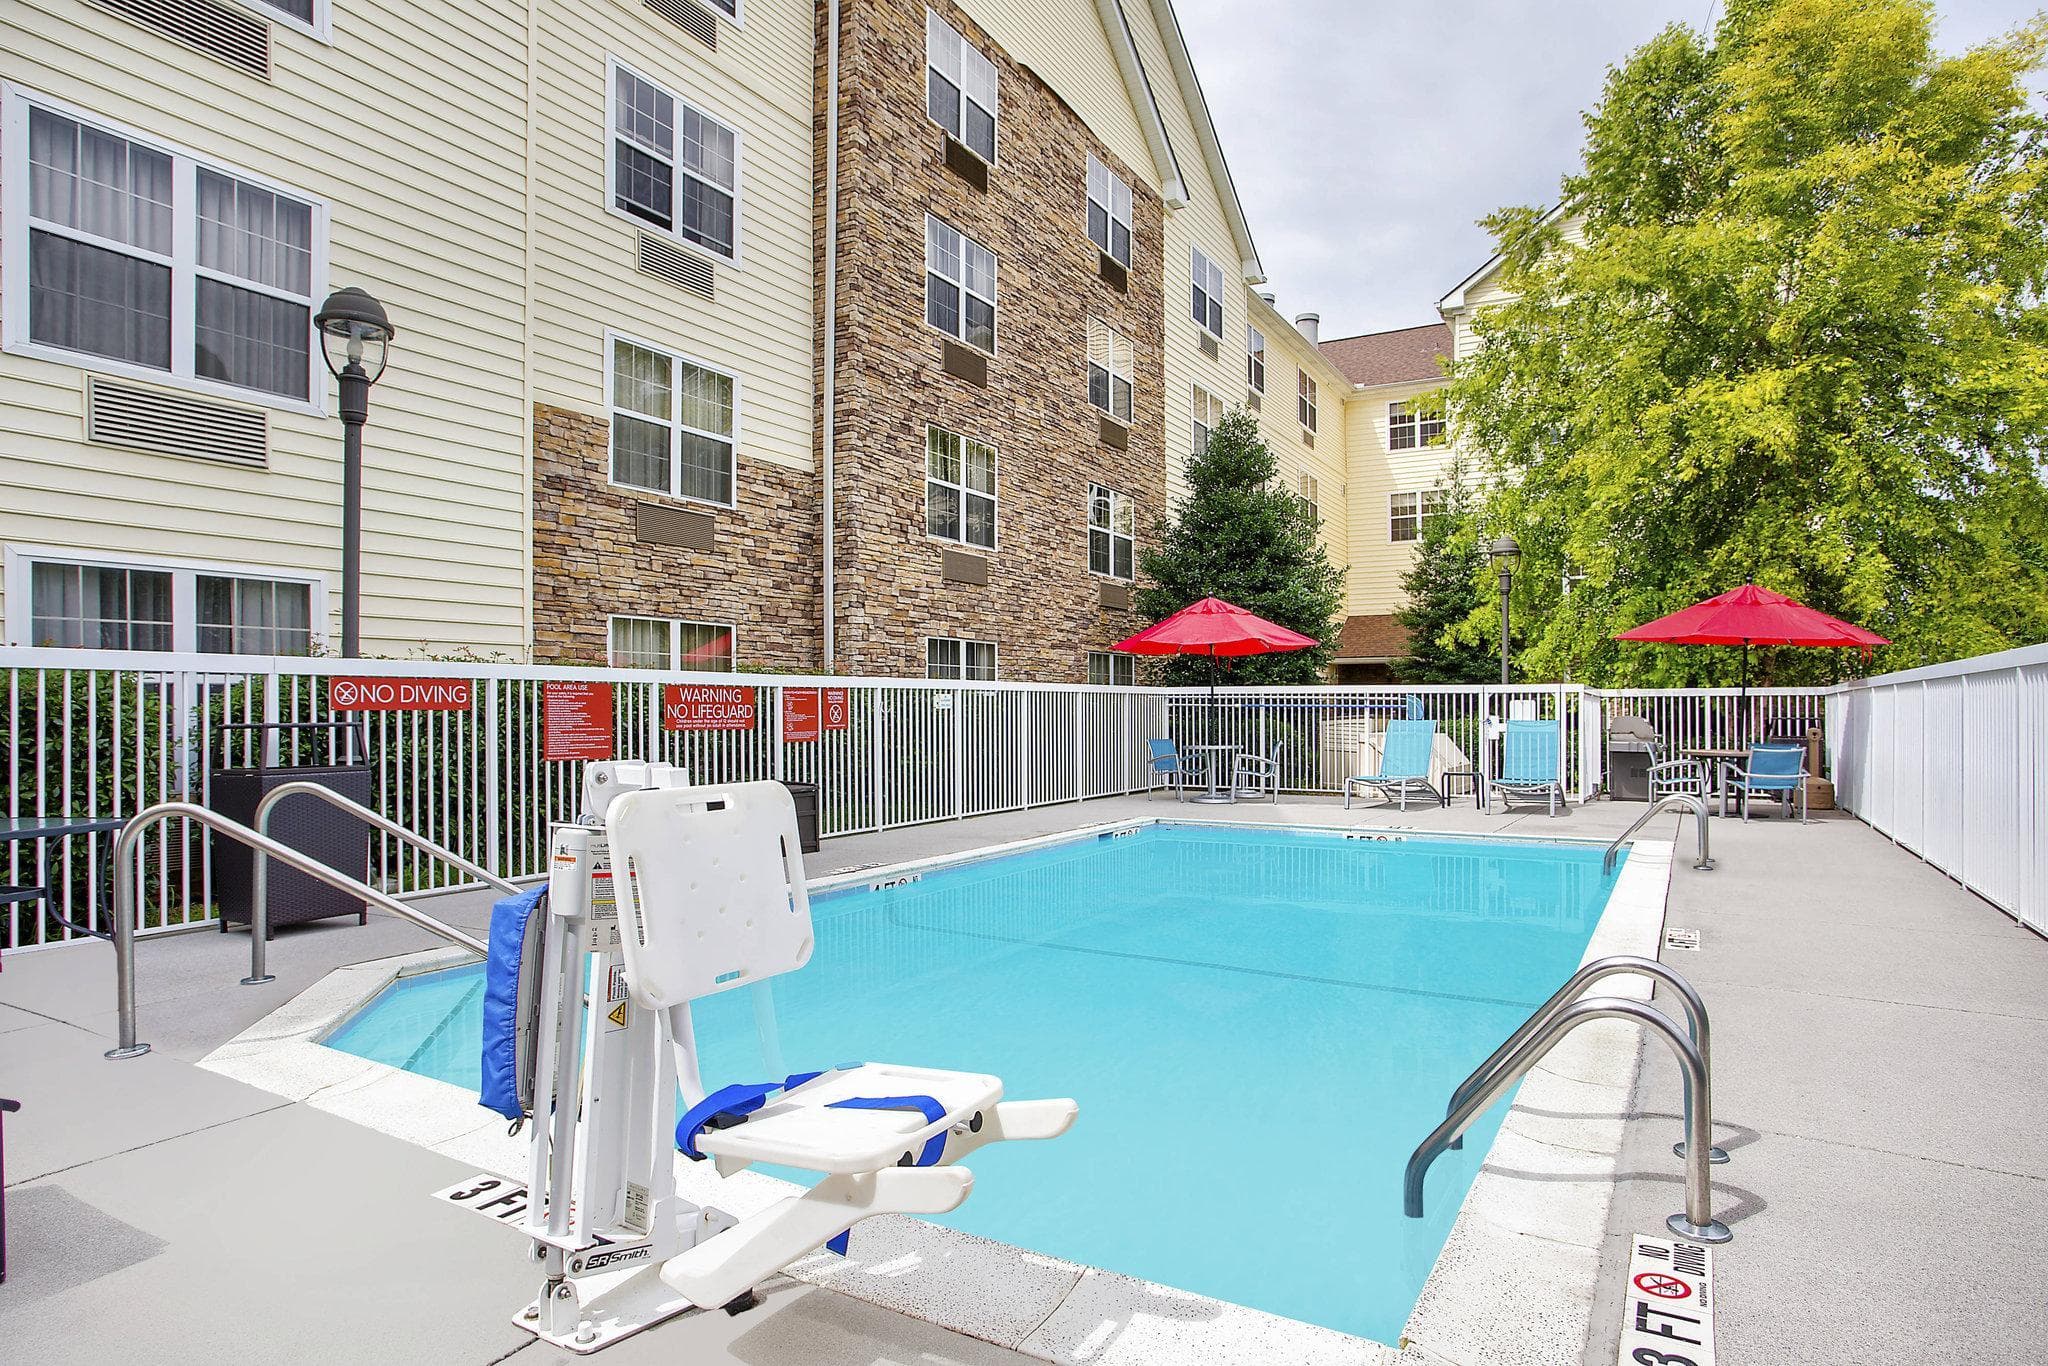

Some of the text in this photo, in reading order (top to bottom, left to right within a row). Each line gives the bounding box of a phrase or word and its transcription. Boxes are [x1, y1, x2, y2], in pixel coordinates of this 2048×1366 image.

[360, 684, 467, 703] NO DIVING
[680, 687, 742, 703] WARNING
[667, 703, 753, 719] NO LIFEGUARD
[449, 1180, 501, 1200] 3
[1638, 1244, 1670, 1261] NO
[1673, 1243, 1706, 1277] DIVING
[1632, 1301, 1702, 1366] 3 FT
